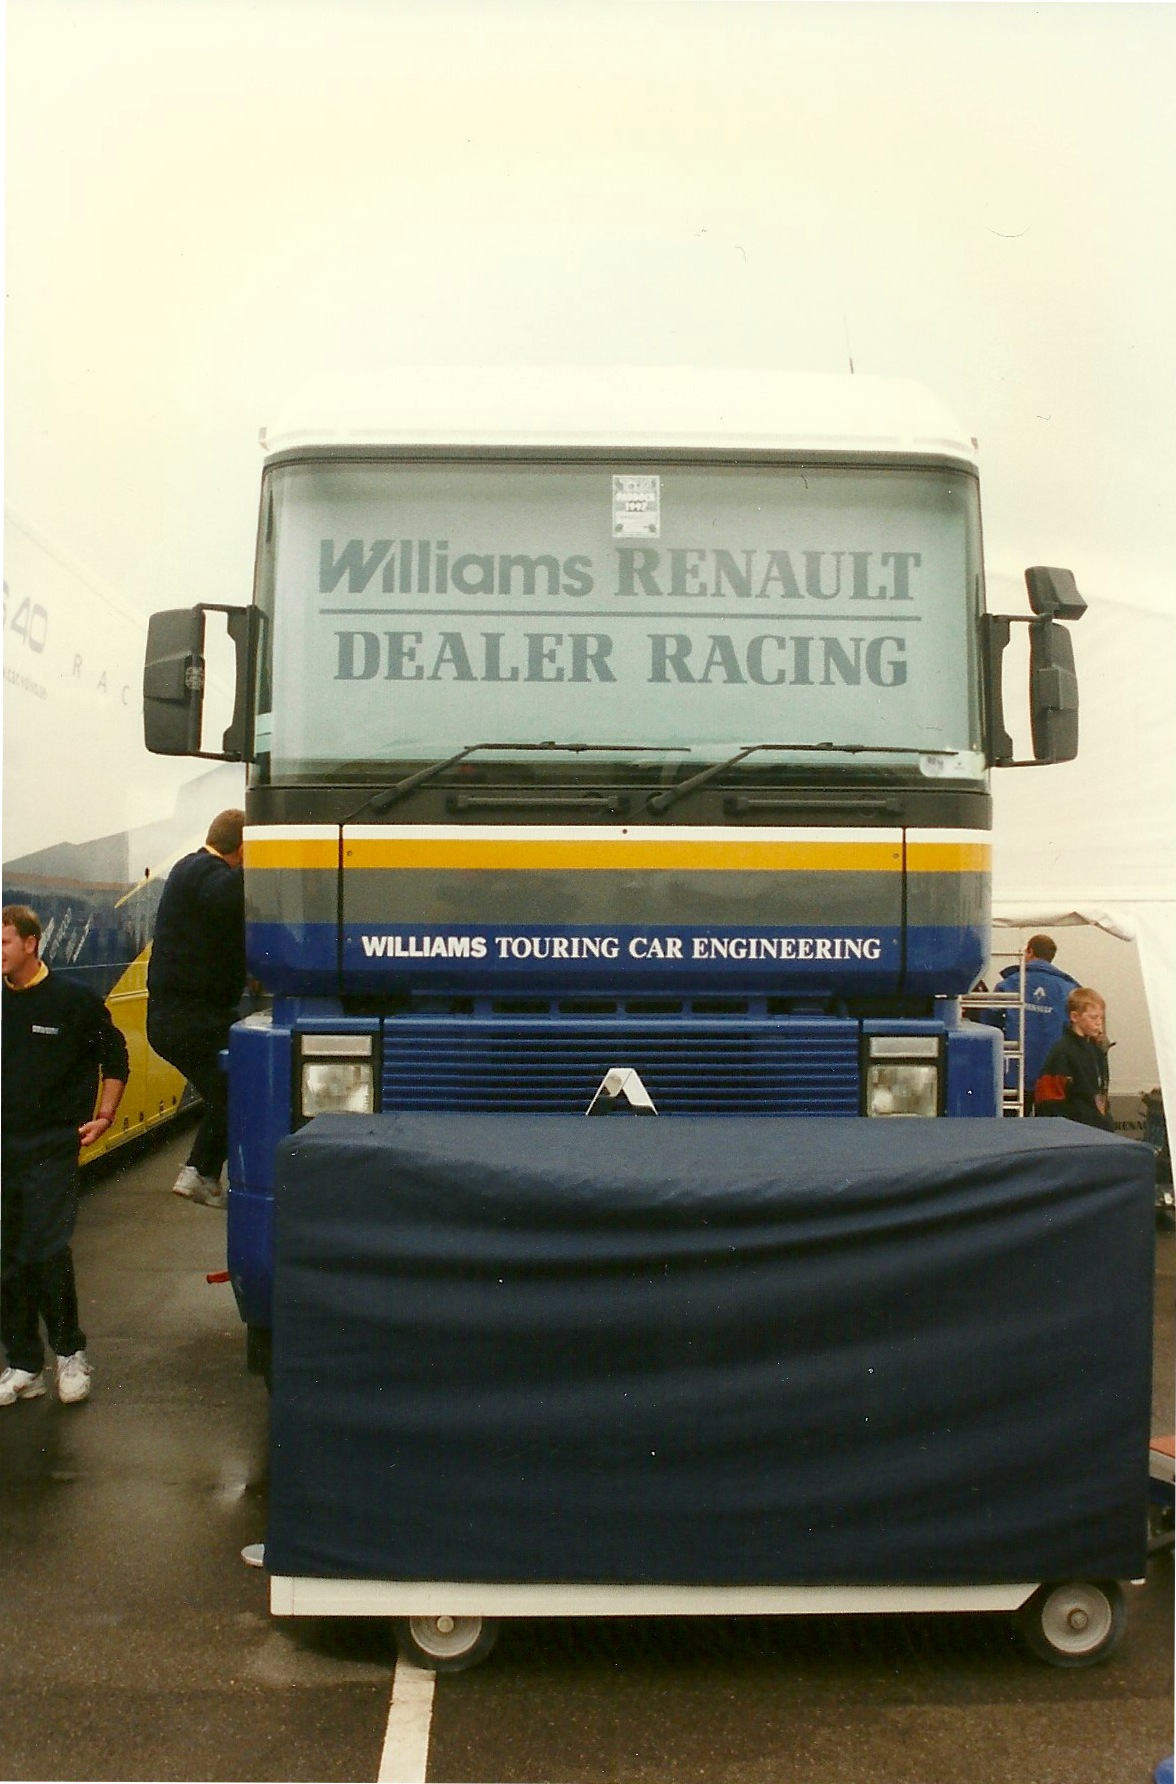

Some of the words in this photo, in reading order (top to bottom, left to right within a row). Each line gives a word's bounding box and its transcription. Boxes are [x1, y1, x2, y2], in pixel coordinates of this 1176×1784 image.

[319, 539, 594, 597] Williams
[614, 547, 922, 600] RENAULT
[3, 579, 48, 654] 40
[333, 631, 617, 682] DEALER
[647, 633, 908, 687] RACING
[361, 936, 487, 958] WILLIAMS
[496, 937, 619, 958] TOURING
[629, 937, 684, 959] CAR
[692, 938, 881, 960] ENGINEERING
